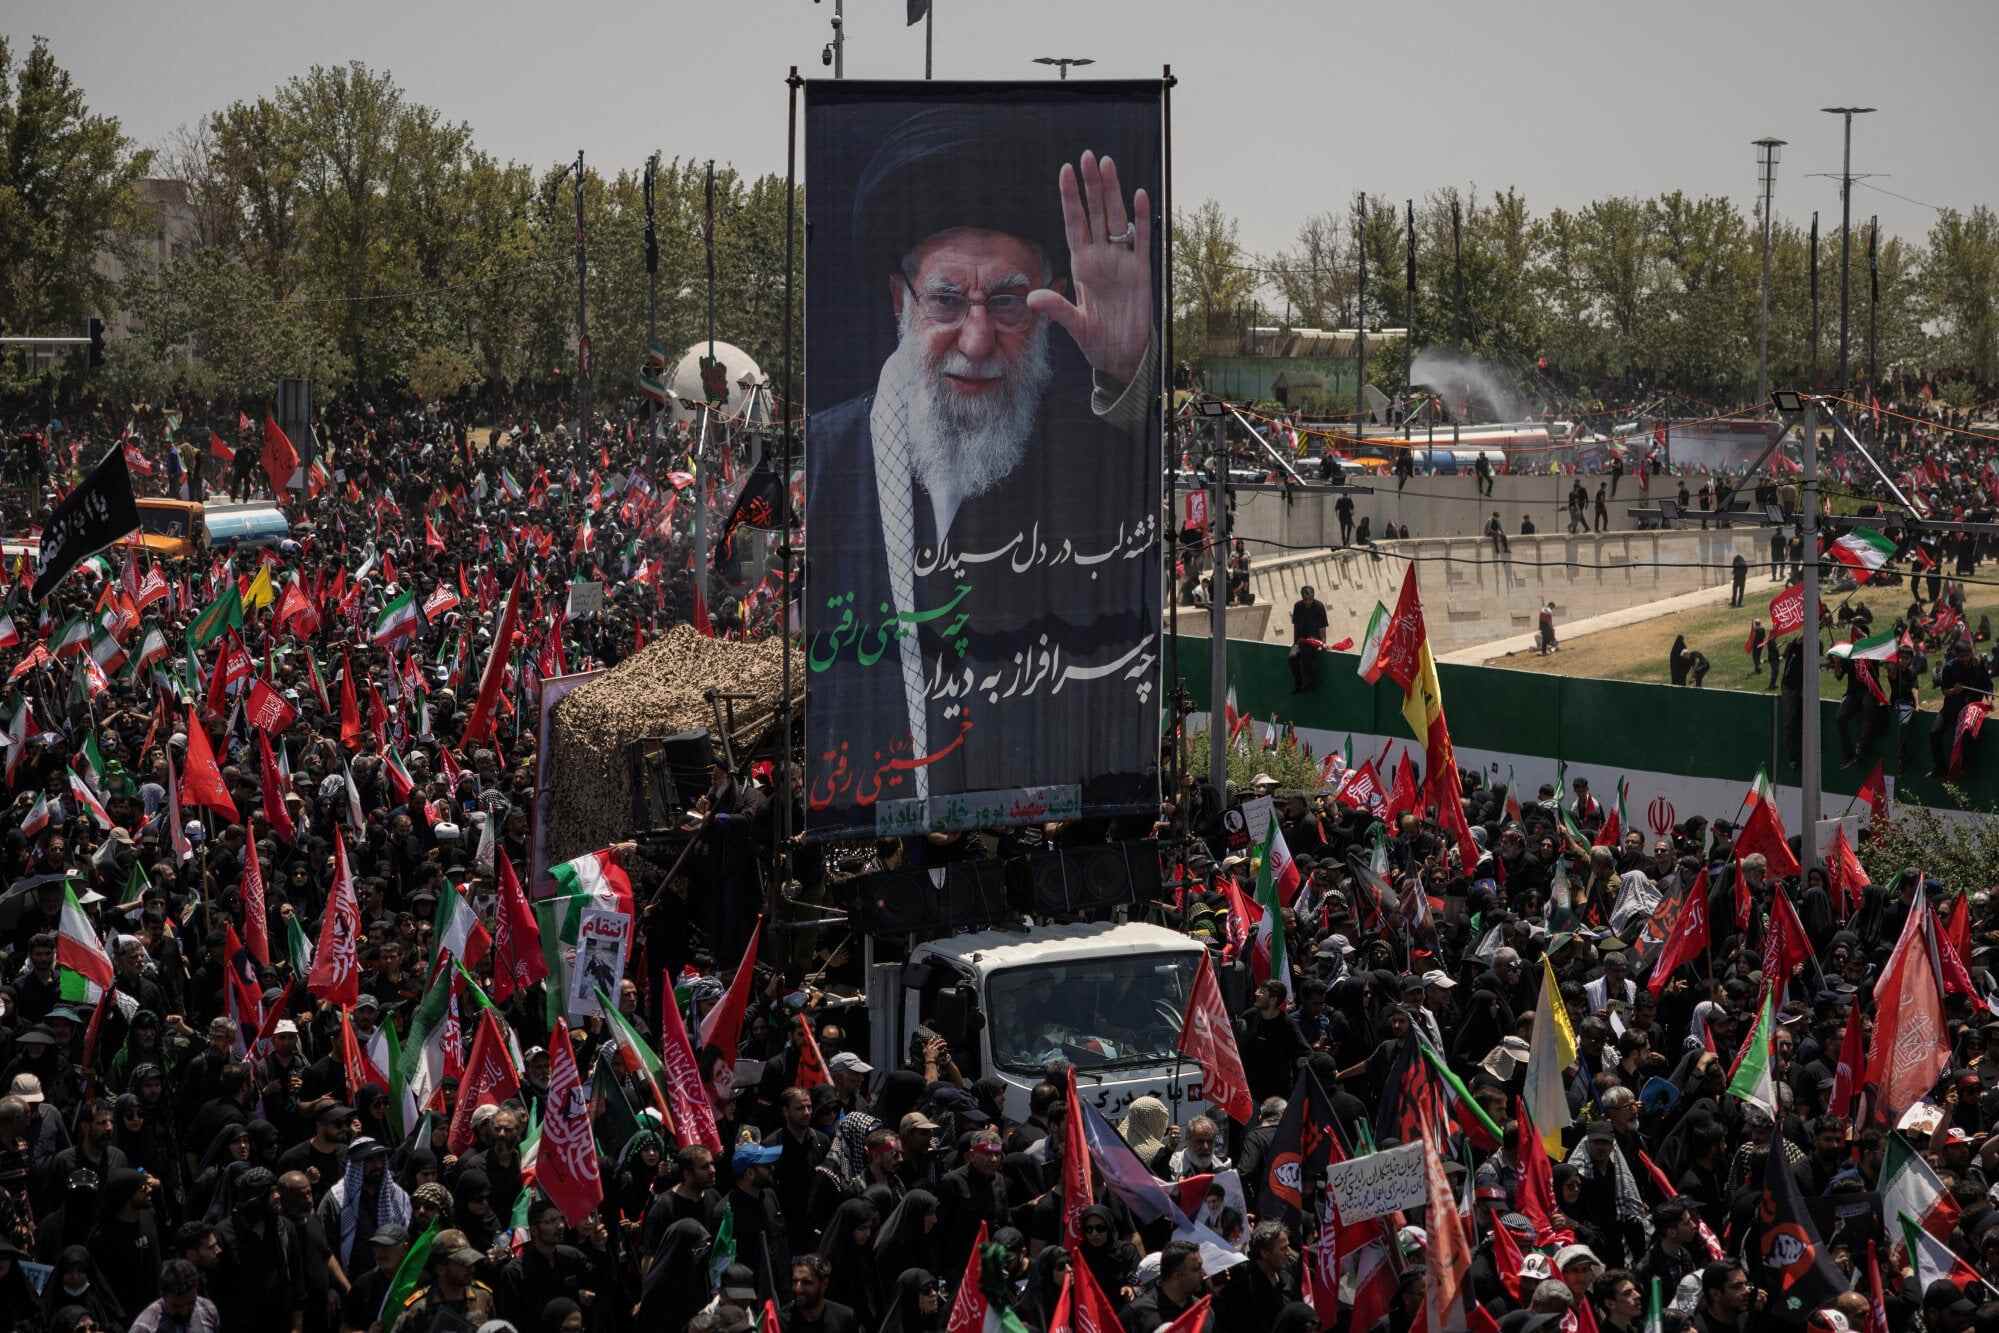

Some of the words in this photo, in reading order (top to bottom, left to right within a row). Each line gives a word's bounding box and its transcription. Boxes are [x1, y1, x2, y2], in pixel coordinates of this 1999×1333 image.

[913, 529, 1024, 579] میدان
[1011, 519, 1048, 573] دل
[1050, 539, 1072, 567] در
[1074, 519, 1125, 580] لب
[1123, 513, 1156, 560] تشنه
[809, 590, 859, 673] رفتی
[857, 580, 974, 666] حسینی
[941, 611, 970, 658] چه
[920, 651, 976, 719] دیدار
[978, 667, 1002, 704] به
[1001, 632, 1155, 700] سرافراز
[1125, 649, 1157, 704] چه
[809, 739, 853, 812] رفتی
[583, 917, 629, 938] انتقام
